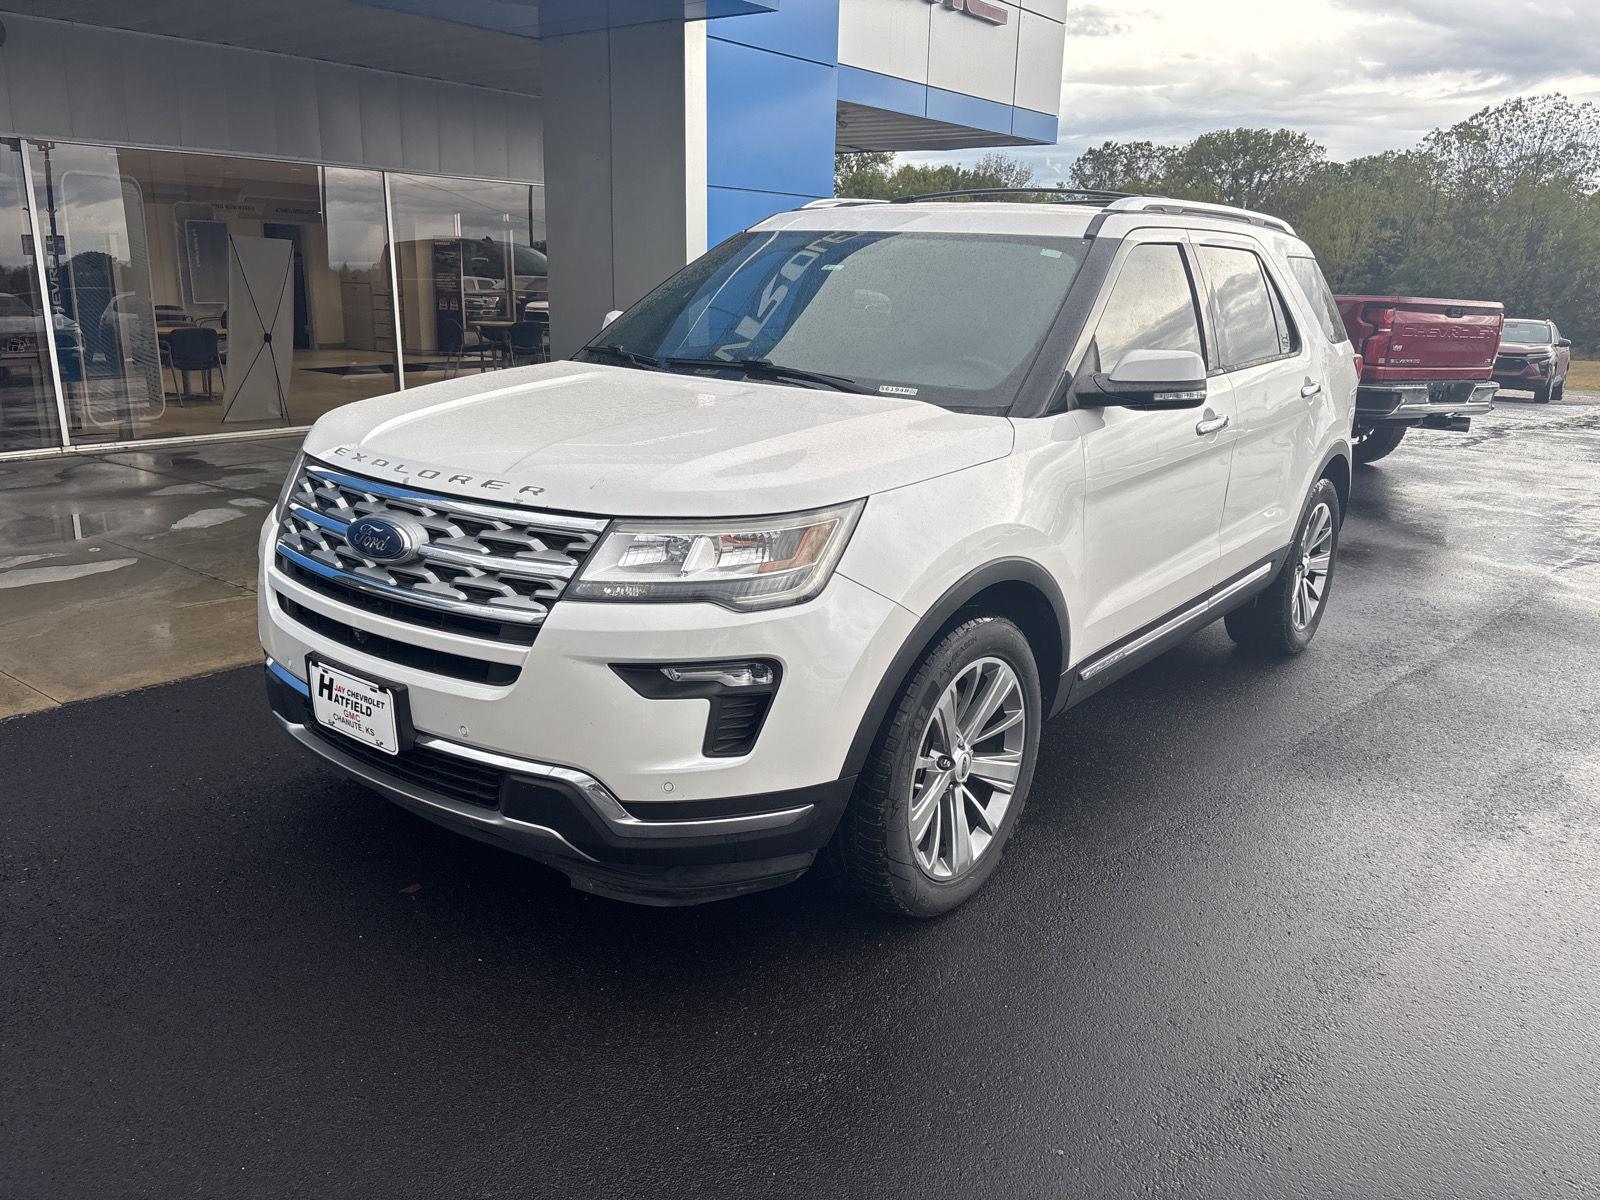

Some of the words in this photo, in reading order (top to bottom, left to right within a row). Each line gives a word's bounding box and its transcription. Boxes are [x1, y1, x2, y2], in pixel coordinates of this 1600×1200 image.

[1401, 326, 1496, 340] CHEVROLET
[334, 447, 545, 496] EXPLORER
[354, 524, 391, 551] Ford
[319, 672, 372, 717] HATFIELD
[334, 684, 345, 694] JAY
[346, 690, 385, 709] CHEVROLET
[333, 713, 364, 734] CHANUTE,
[365, 727, 375, 737] KS
[343, 709, 361, 722] GMC
